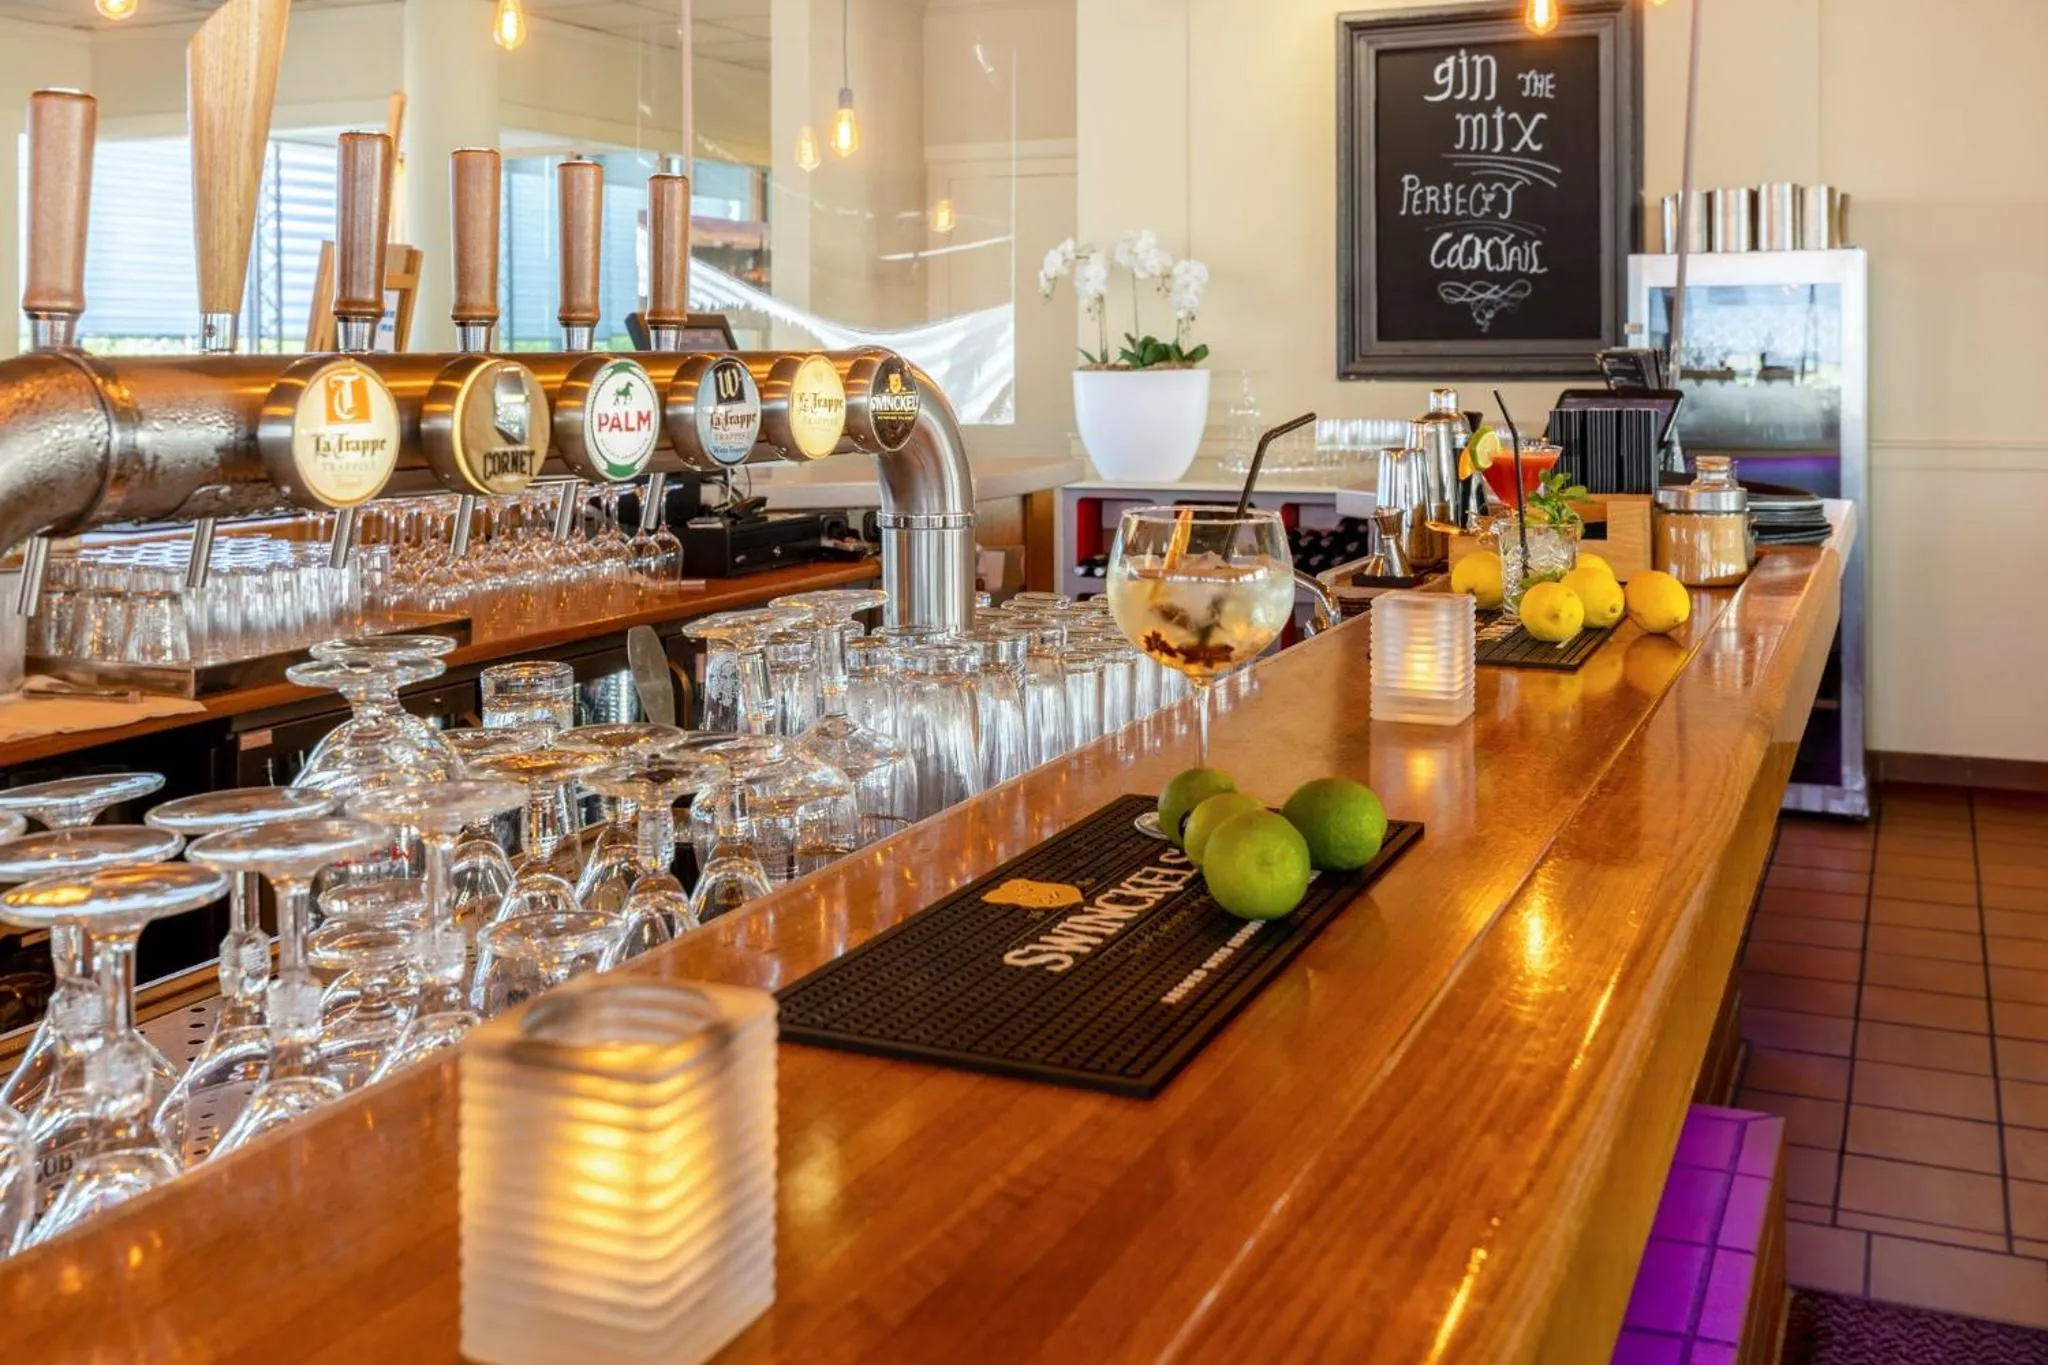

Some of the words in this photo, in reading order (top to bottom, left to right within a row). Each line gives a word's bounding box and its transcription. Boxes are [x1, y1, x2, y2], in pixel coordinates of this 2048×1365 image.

[1423, 48, 1498, 102] gin
[1517, 69, 1556, 99] THE
[811, 392, 844, 413] Trappe
[597, 410, 652, 432] PALM
[721, 410, 757, 431] Trappe
[310, 433, 331, 459] La
[333, 433, 387, 459] Trappe
[483, 449, 535, 480] CORNET
